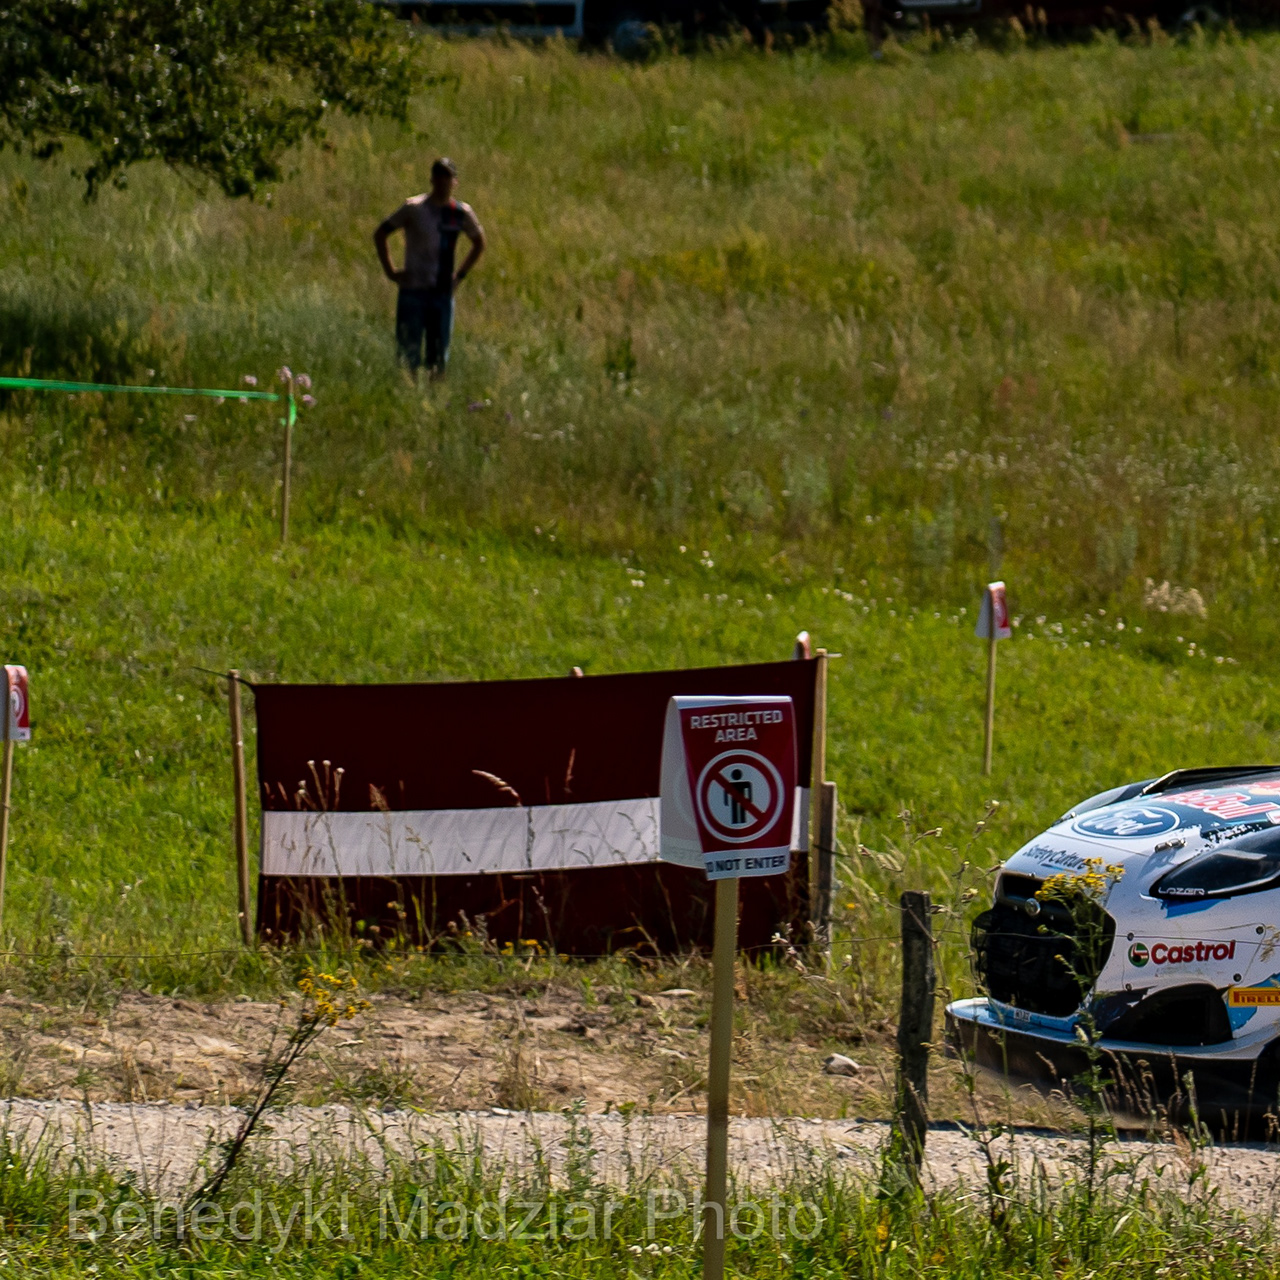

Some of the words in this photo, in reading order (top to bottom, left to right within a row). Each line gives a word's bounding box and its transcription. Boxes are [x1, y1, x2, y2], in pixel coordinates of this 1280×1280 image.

[691, 710, 783, 730] RESTRICTED
[715, 727, 758, 743] AREA
[1082, 808, 1164, 835] Ford
[715, 858, 742, 872] NOT
[744, 854, 786, 870] ENTER
[1151, 939, 1236, 965] Castrol
